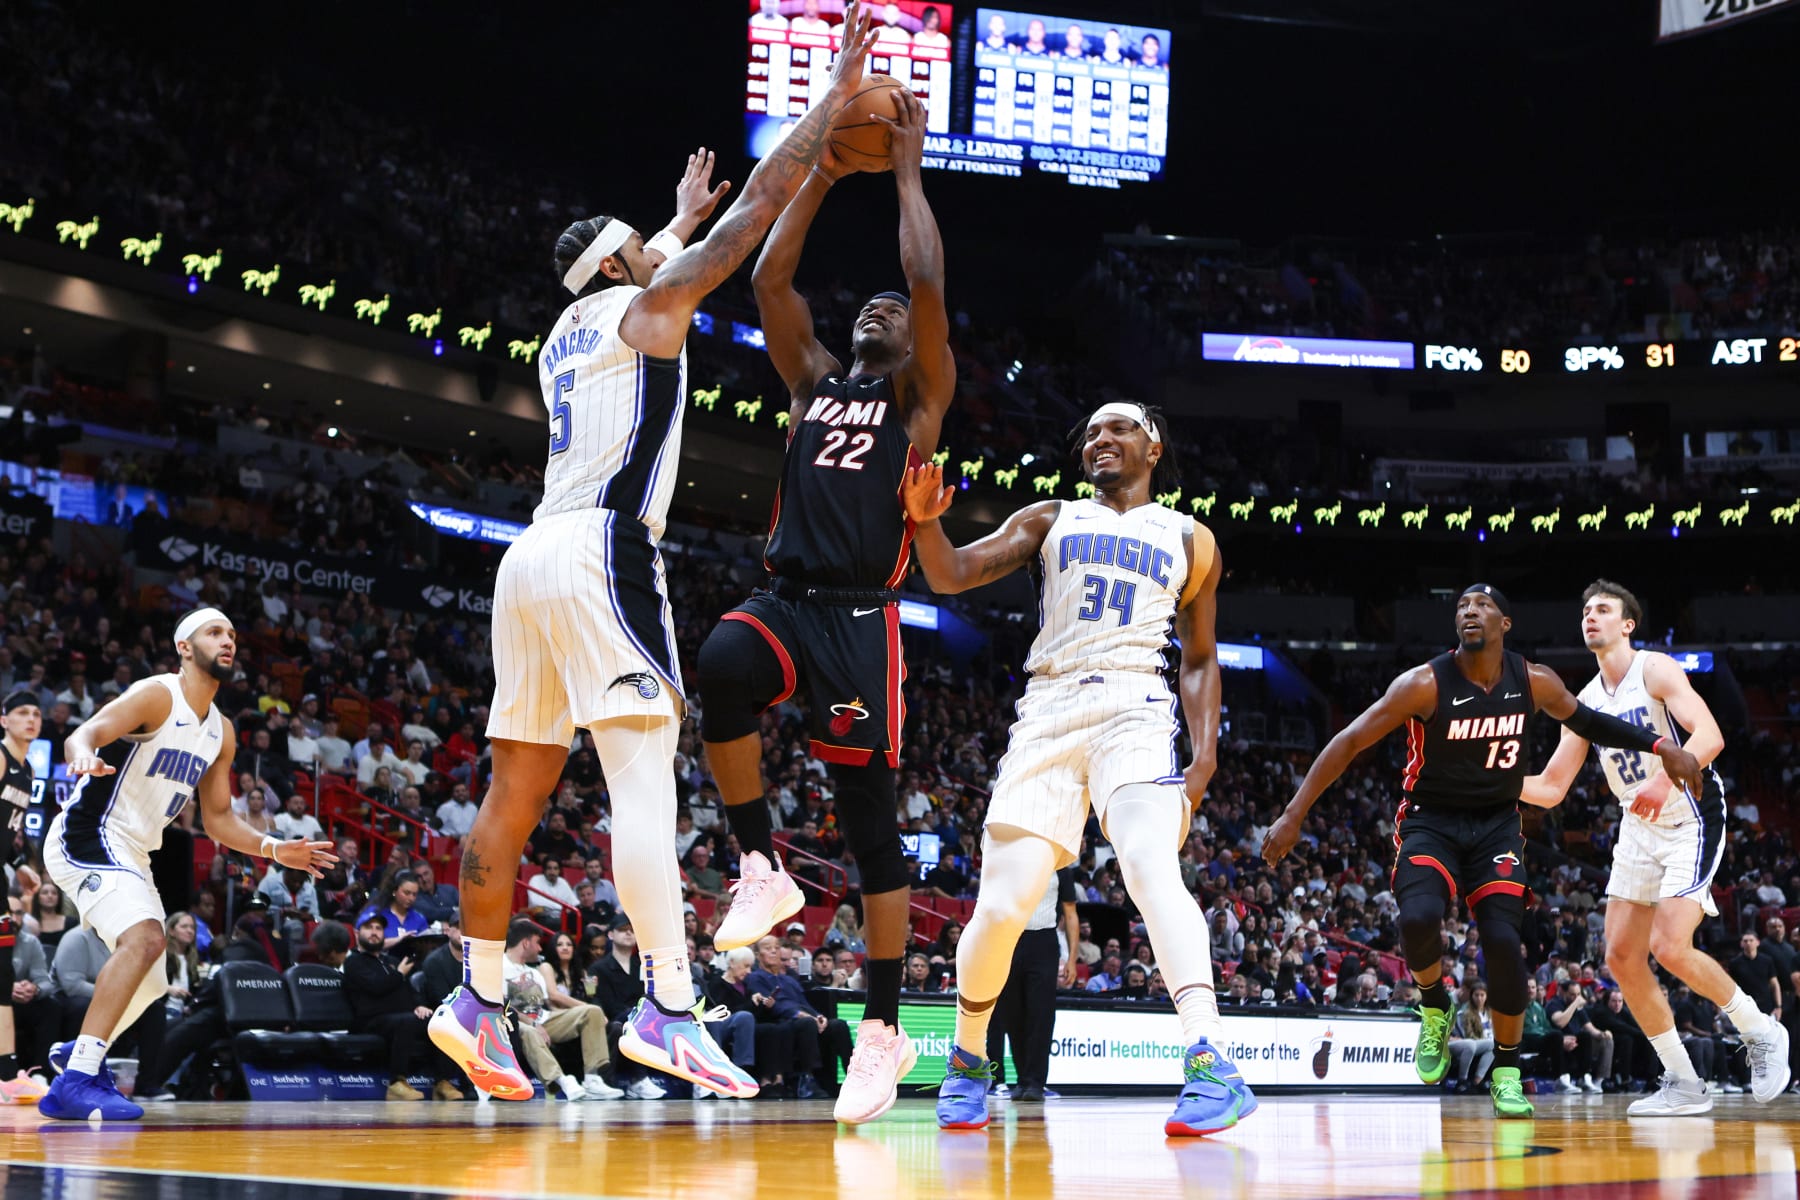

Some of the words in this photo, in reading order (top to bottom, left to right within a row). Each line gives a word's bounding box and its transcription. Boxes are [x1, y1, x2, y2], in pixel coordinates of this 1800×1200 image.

[966, 141, 1024, 160] LEVINE
[948, 160, 1022, 176] ATTORNEYS
[1099, 168, 1149, 181] ACCIDENTS
[545, 328, 603, 375] BANCHERO
[1425, 344, 1483, 371] FG%
[1501, 349, 1530, 373] 50
[1565, 346, 1624, 371] 3P%
[1646, 343, 1675, 367] 31
[1711, 338, 1767, 365] AST
[549, 368, 576, 457] 5
[803, 396, 888, 427] MIAMI
[813, 429, 875, 470] 22
[1060, 532, 1174, 590] MAGIC
[294, 560, 376, 593] Center
[1078, 573, 1137, 627] 34
[1447, 713, 1525, 739] MIAMI
[1485, 740, 1521, 769] 13
[1610, 748, 1647, 785] 22
[236, 980, 282, 989] AMERANT
[299, 977, 342, 987] AMERANT
[1050, 1038, 1106, 1057] Official
[1262, 1042, 1275, 1061] of
[1279, 1042, 1300, 1061] the
[1343, 1046, 1390, 1063] MIAMI
[250, 1078, 268, 1086] ONE
[272, 1075, 311, 1088] Sotheby's
[339, 1075, 375, 1088] Sotheby's
